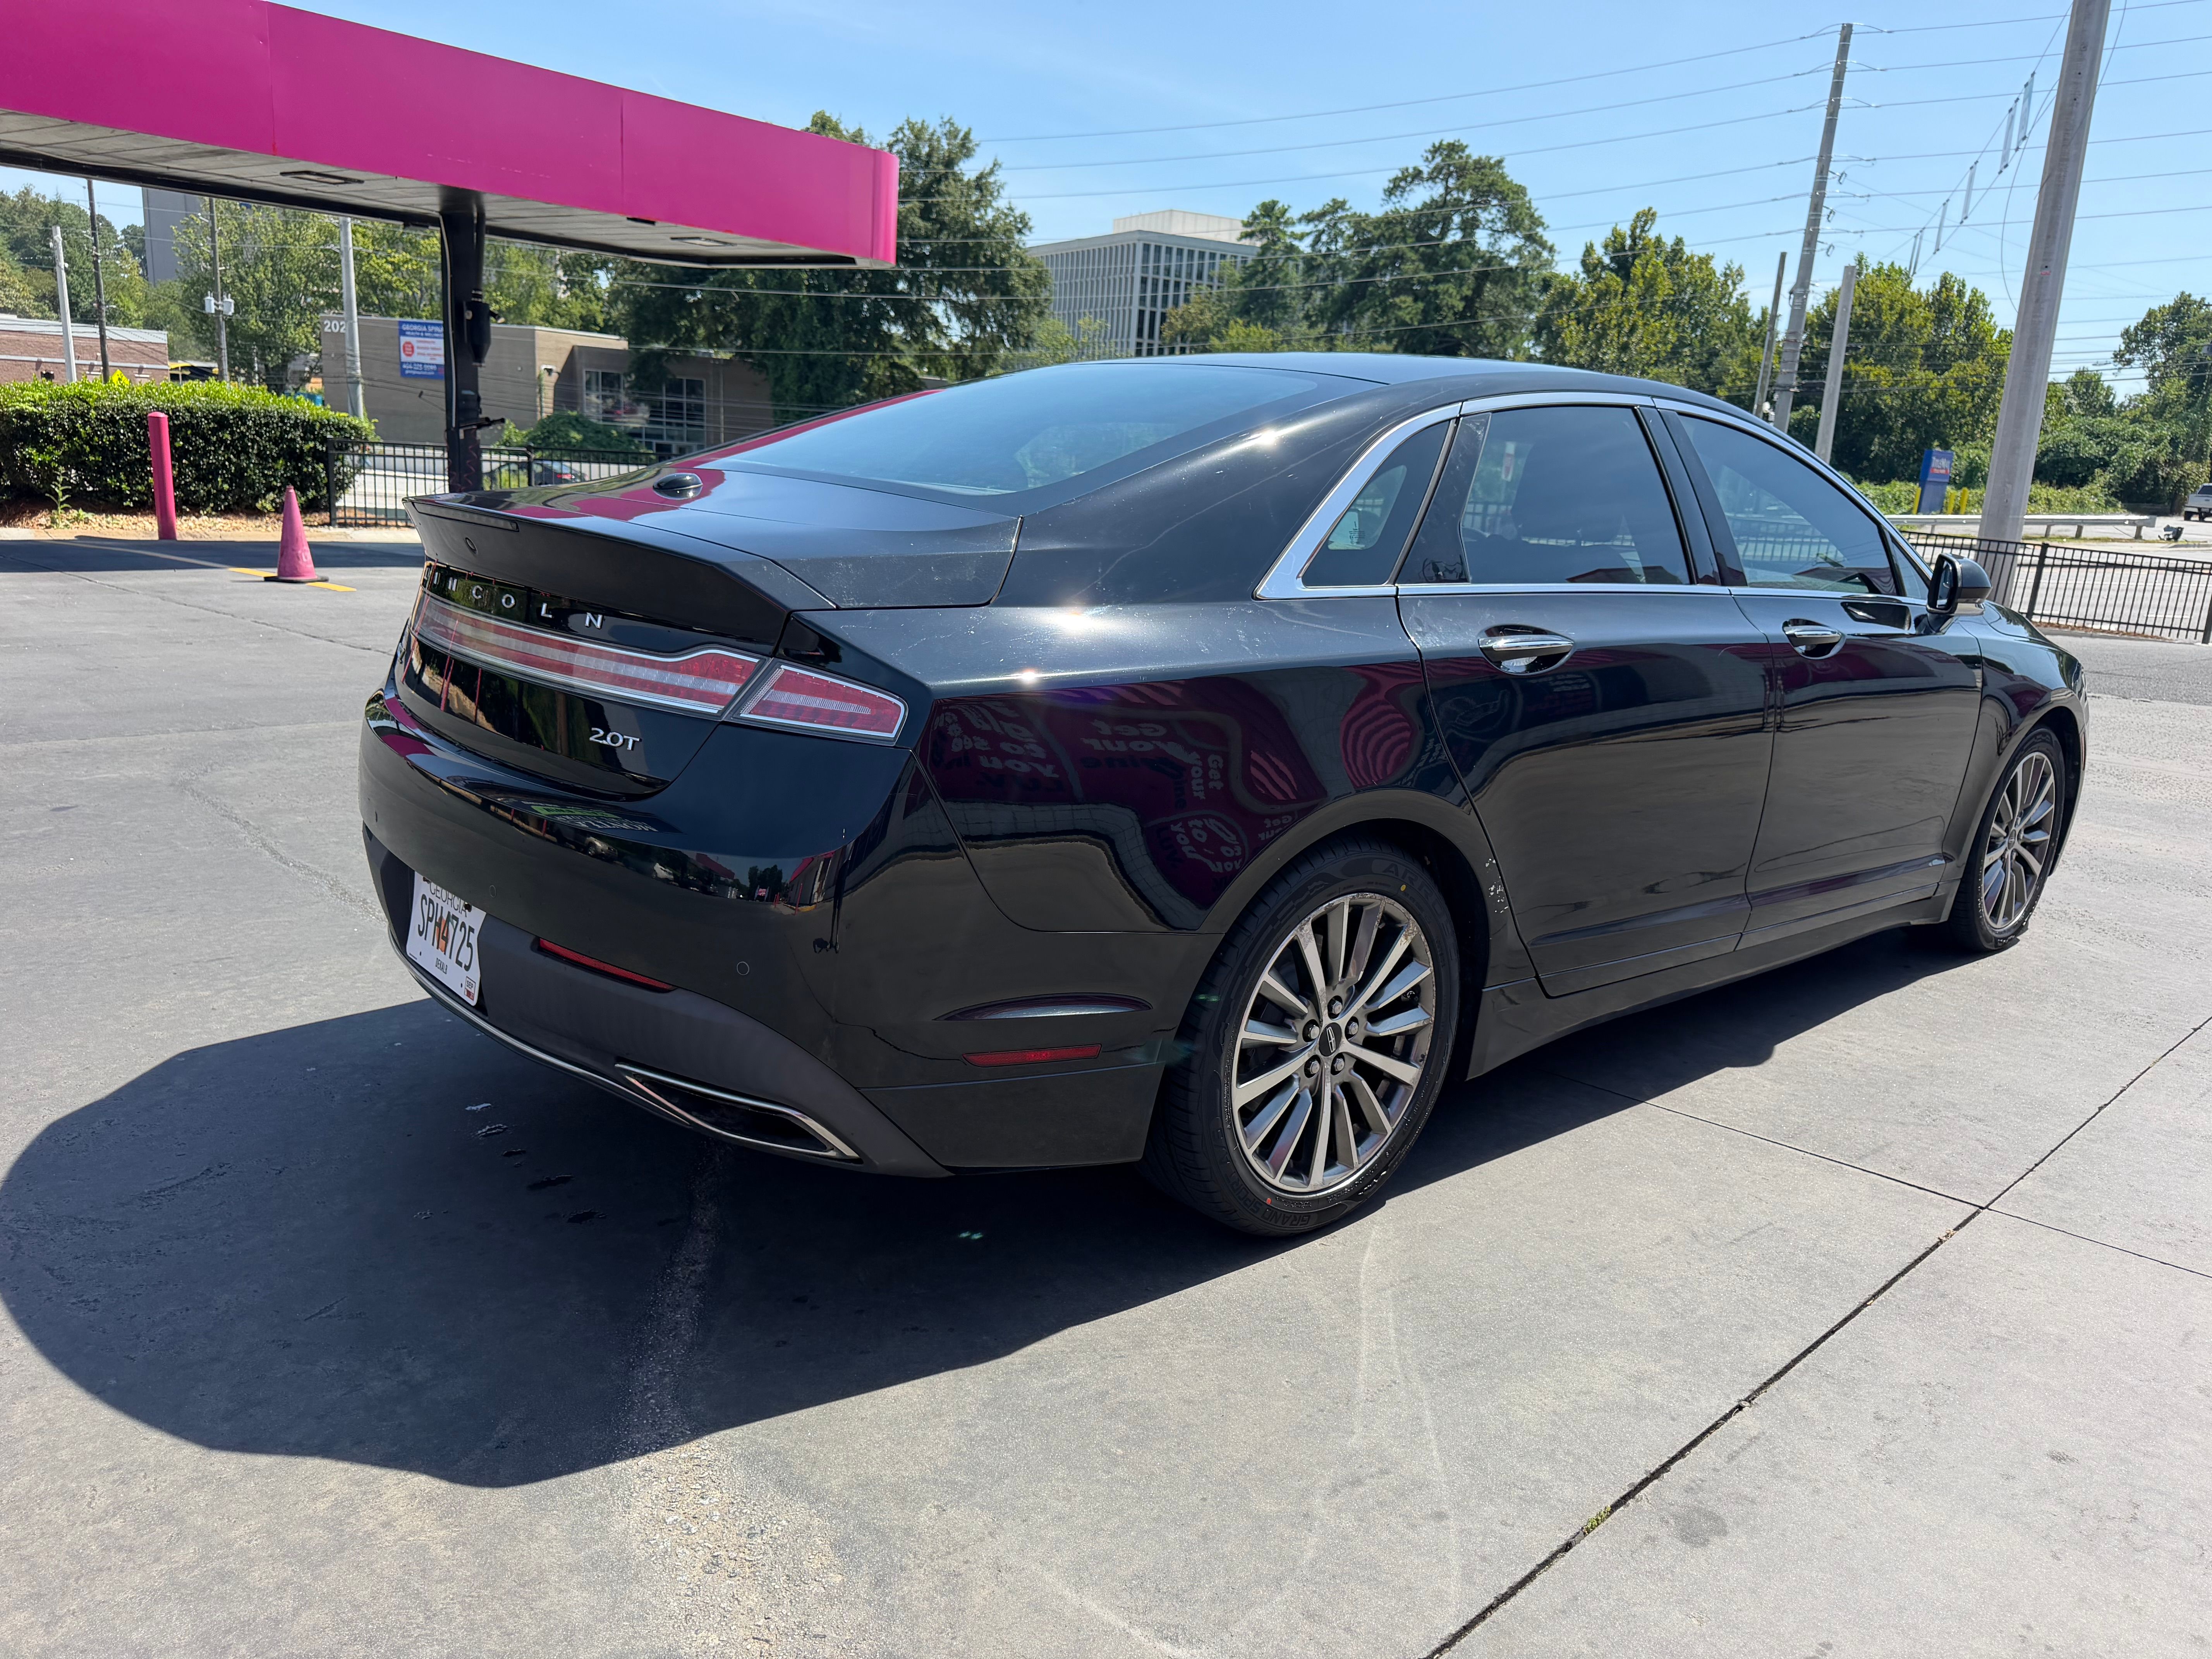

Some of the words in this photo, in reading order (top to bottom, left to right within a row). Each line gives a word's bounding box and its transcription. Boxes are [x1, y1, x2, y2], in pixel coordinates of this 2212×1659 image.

[424, 566, 603, 629] LINCOLN
[417, 894, 475, 972] SPH4725
[435, 957, 448, 975] DEKALB
[1260, 1203, 1312, 1227] GRAND
